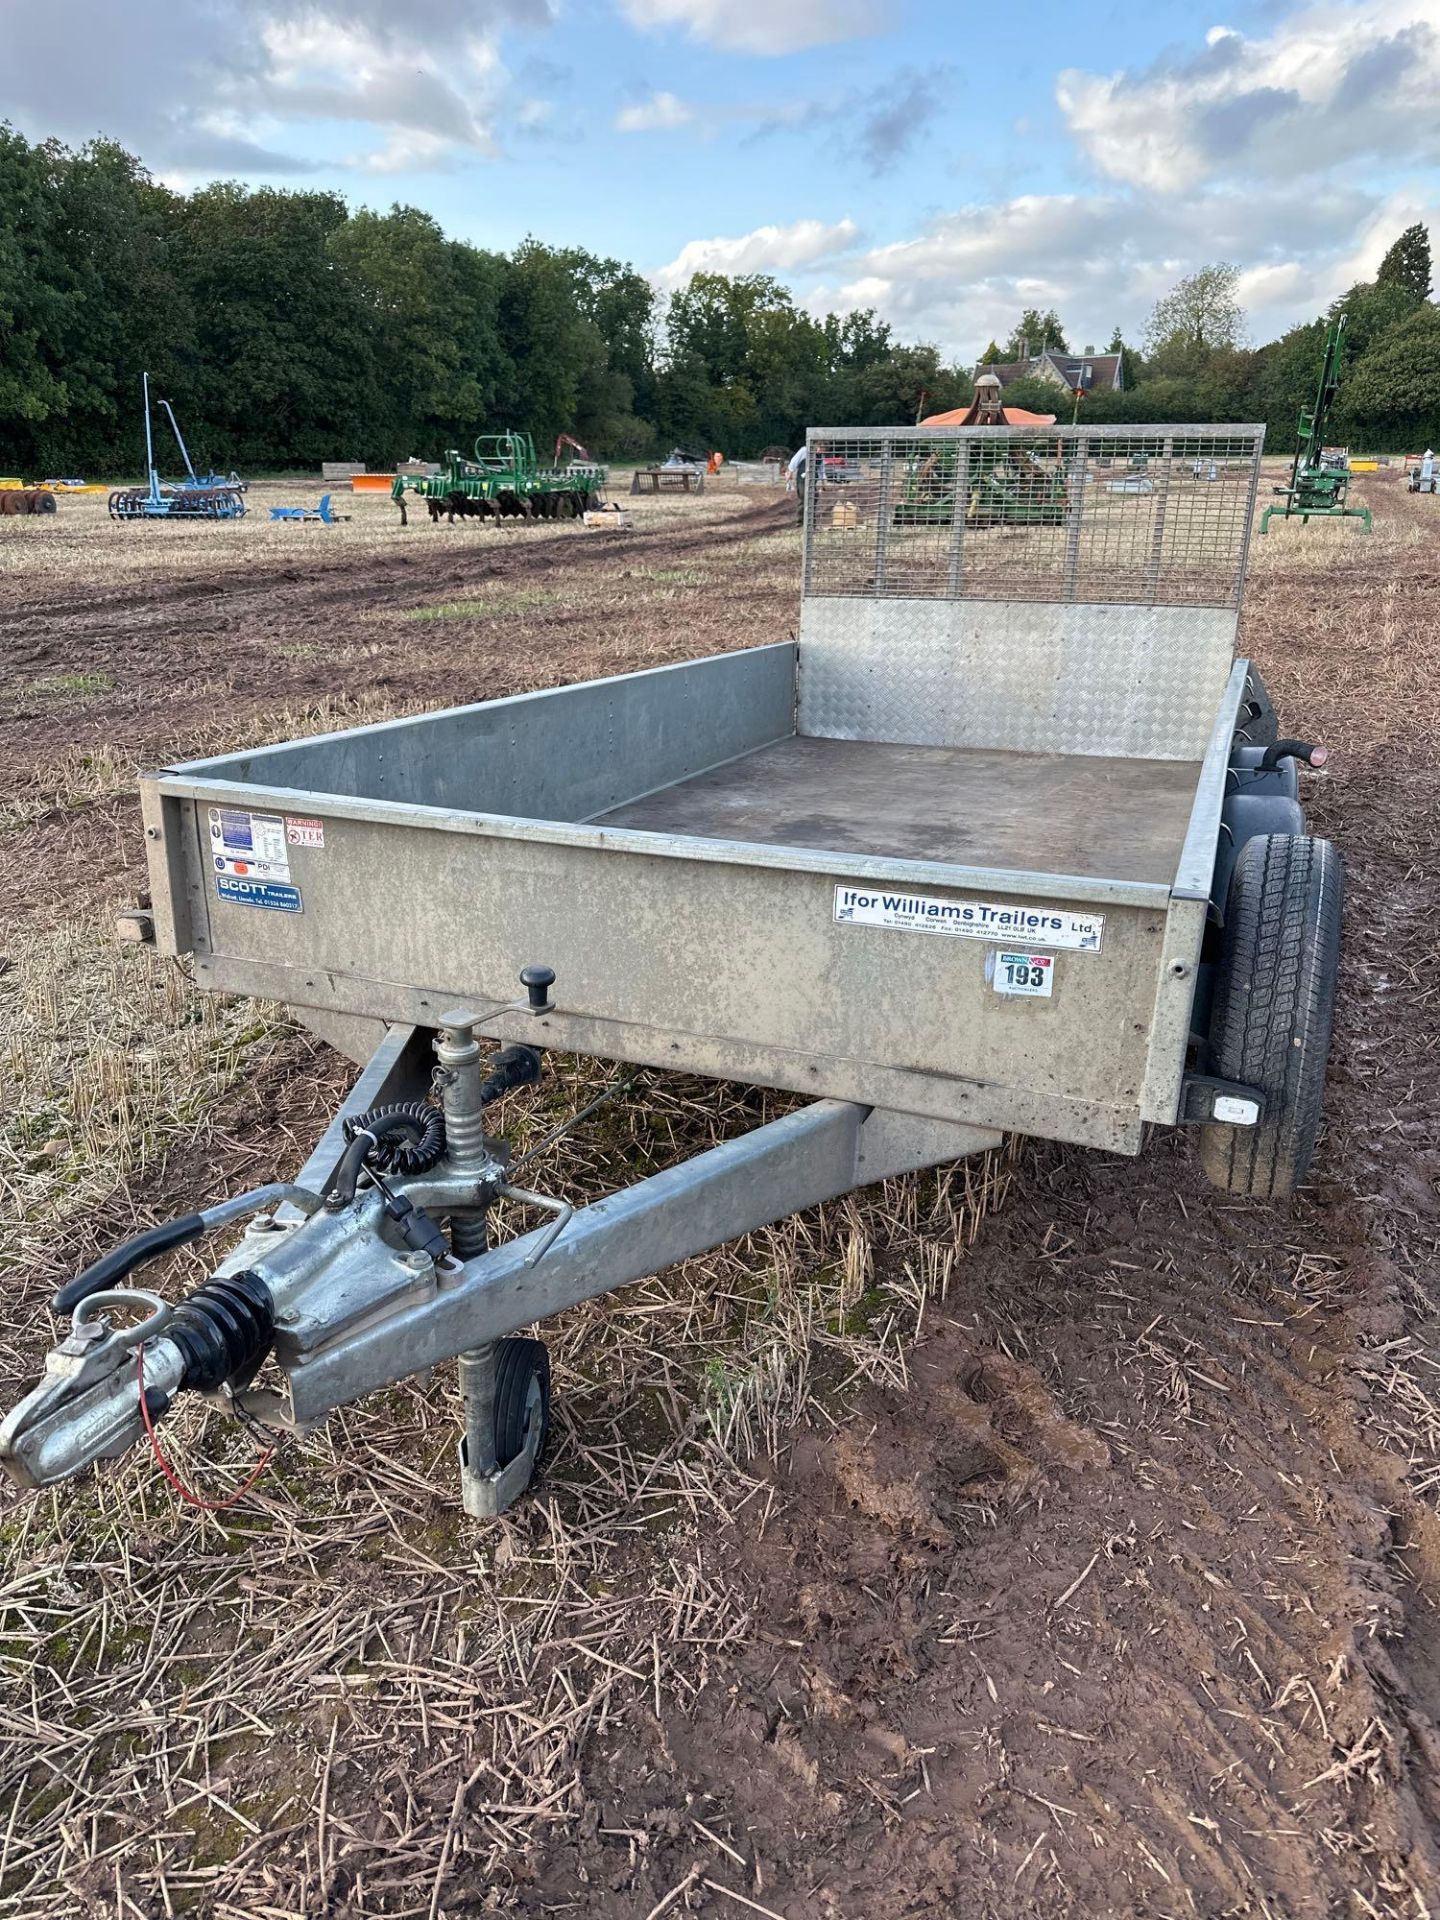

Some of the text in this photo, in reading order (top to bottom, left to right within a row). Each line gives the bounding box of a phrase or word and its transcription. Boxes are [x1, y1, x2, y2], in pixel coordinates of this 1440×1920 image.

[219, 878, 297, 900] SCOTT TRAILERS
[844, 891, 878, 908] Ifor
[882, 896, 973, 920] Williams
[979, 907, 1062, 930] Trailers
[1005, 964, 1044, 987] 193
